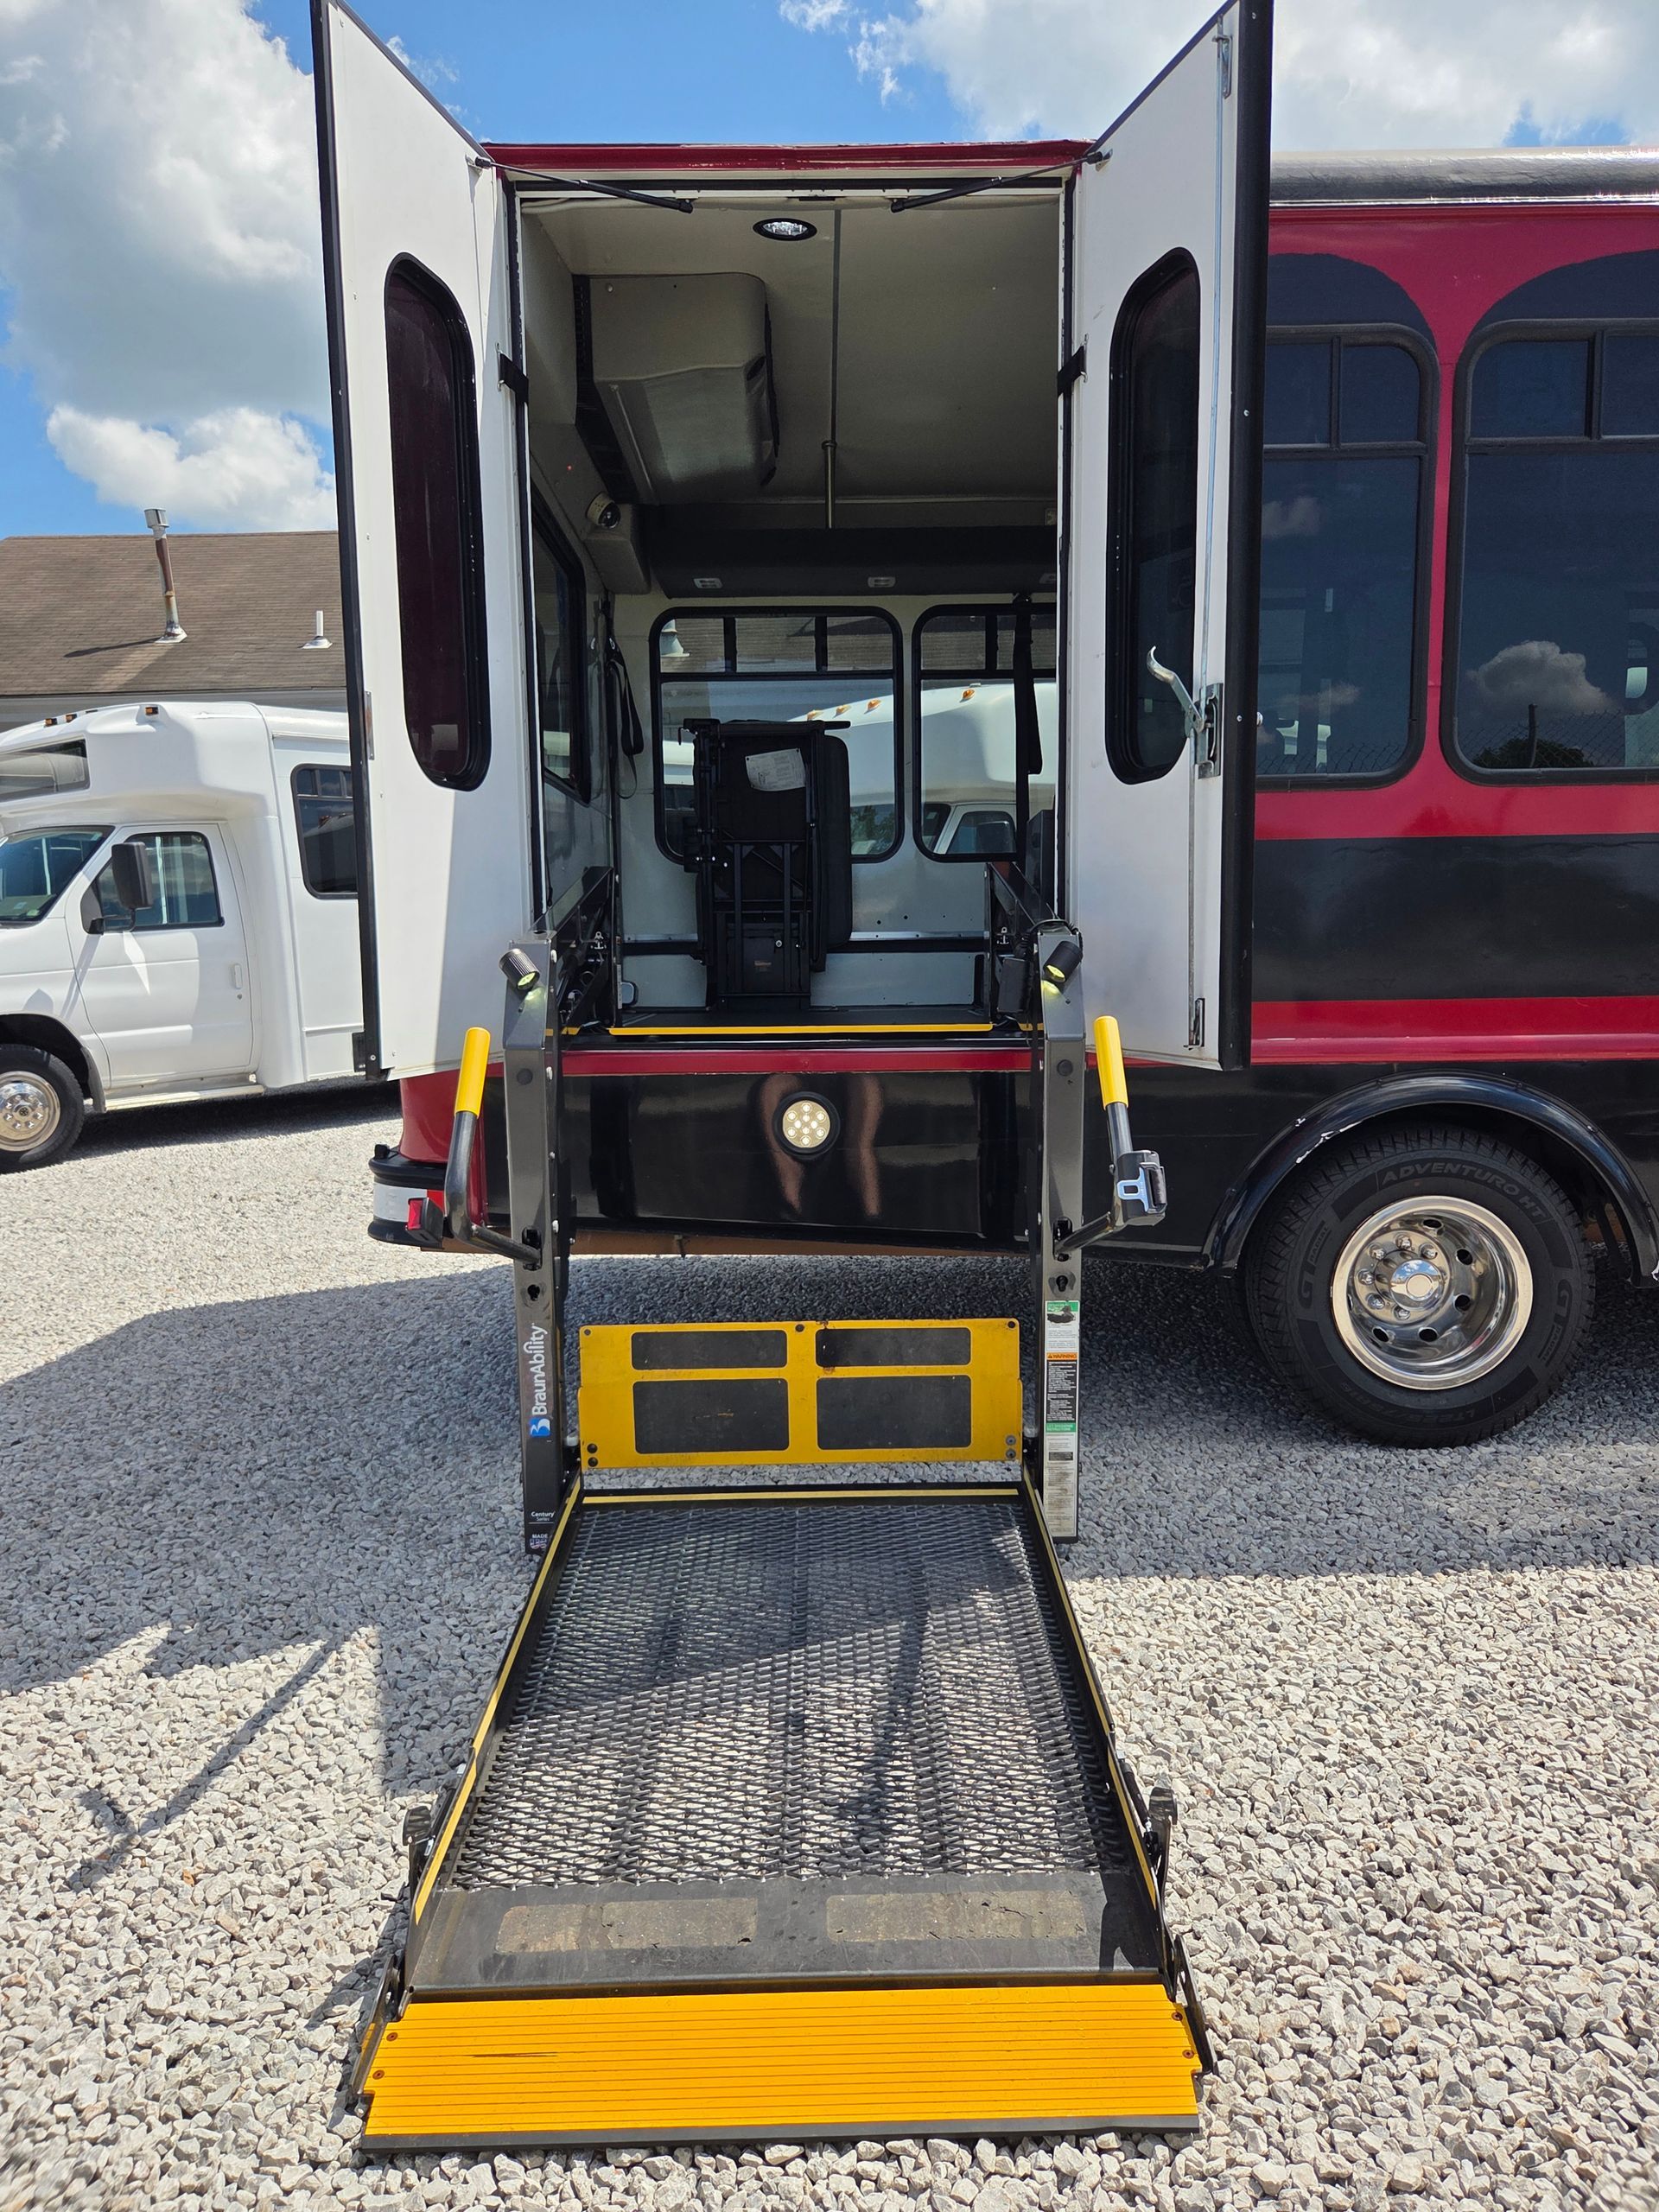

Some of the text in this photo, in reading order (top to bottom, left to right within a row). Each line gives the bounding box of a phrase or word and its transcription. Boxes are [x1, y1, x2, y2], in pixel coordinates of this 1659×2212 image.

[1382, 1161, 1548, 1219] ADVENTURO HT
[523, 1325, 549, 1415] BraunAbility
